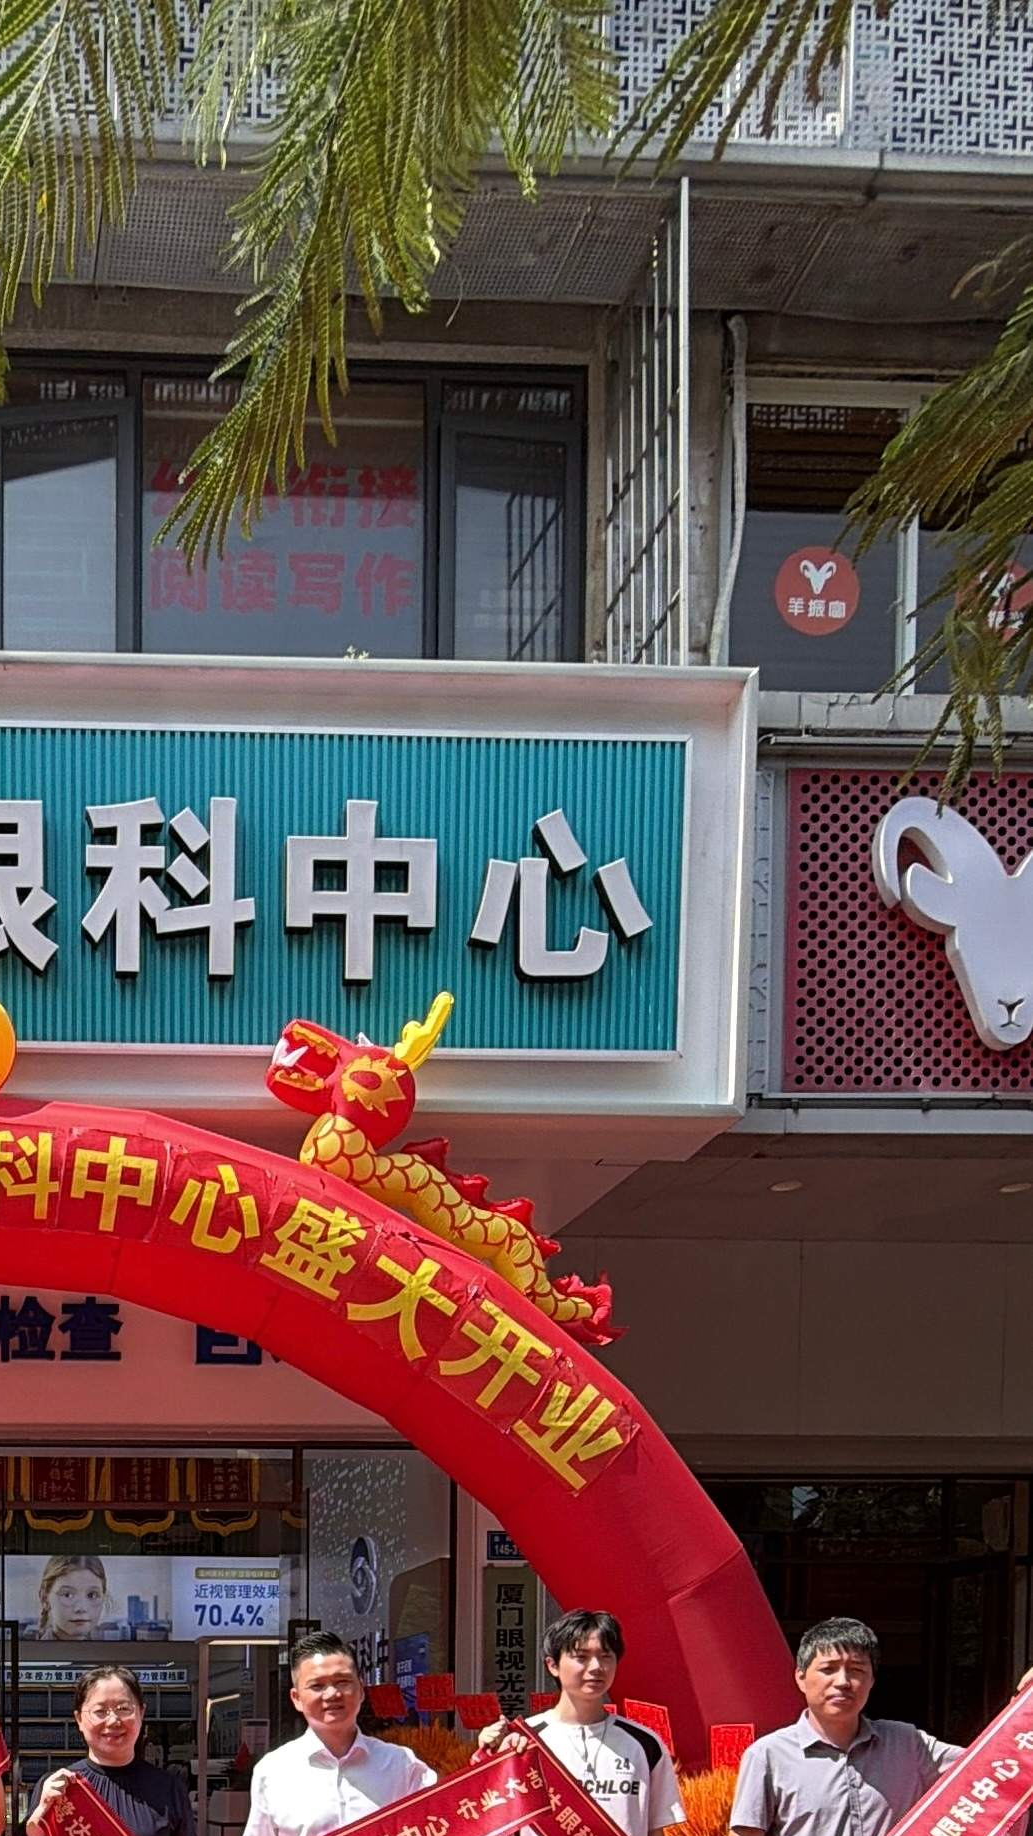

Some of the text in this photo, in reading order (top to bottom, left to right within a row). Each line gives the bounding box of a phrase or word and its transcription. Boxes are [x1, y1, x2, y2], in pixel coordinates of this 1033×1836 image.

[151, 549, 415, 617] 阅读写作
[194, 1604, 264, 1626] 70.4%
[495, 1583, 526, 1720] 厦门眼视光学
[614, 1758, 630, 1770] 24
[456, 1766, 545, 1820] 开业大吉
